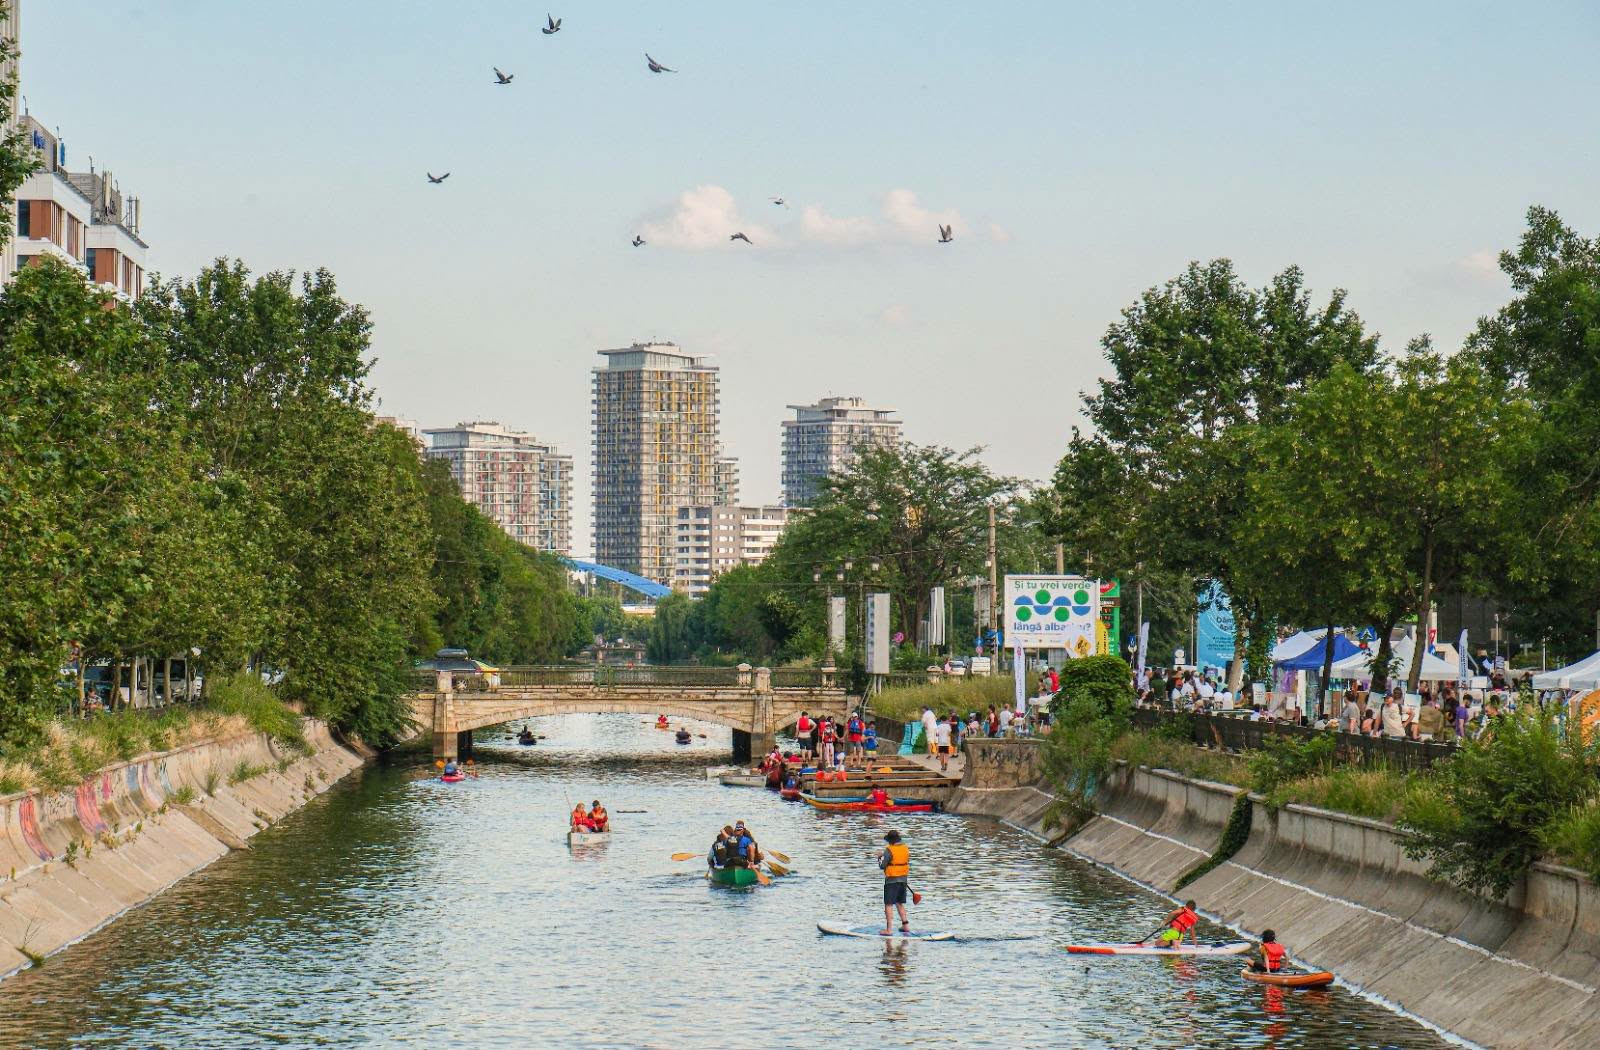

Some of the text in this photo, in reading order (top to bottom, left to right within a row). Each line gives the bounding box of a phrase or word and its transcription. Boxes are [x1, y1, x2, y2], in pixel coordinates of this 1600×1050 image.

[1027, 581, 1037, 589] tu
[1040, 580, 1059, 590] vrei
[1062, 581, 1091, 590] verde
[1013, 622, 1042, 632] lângă
